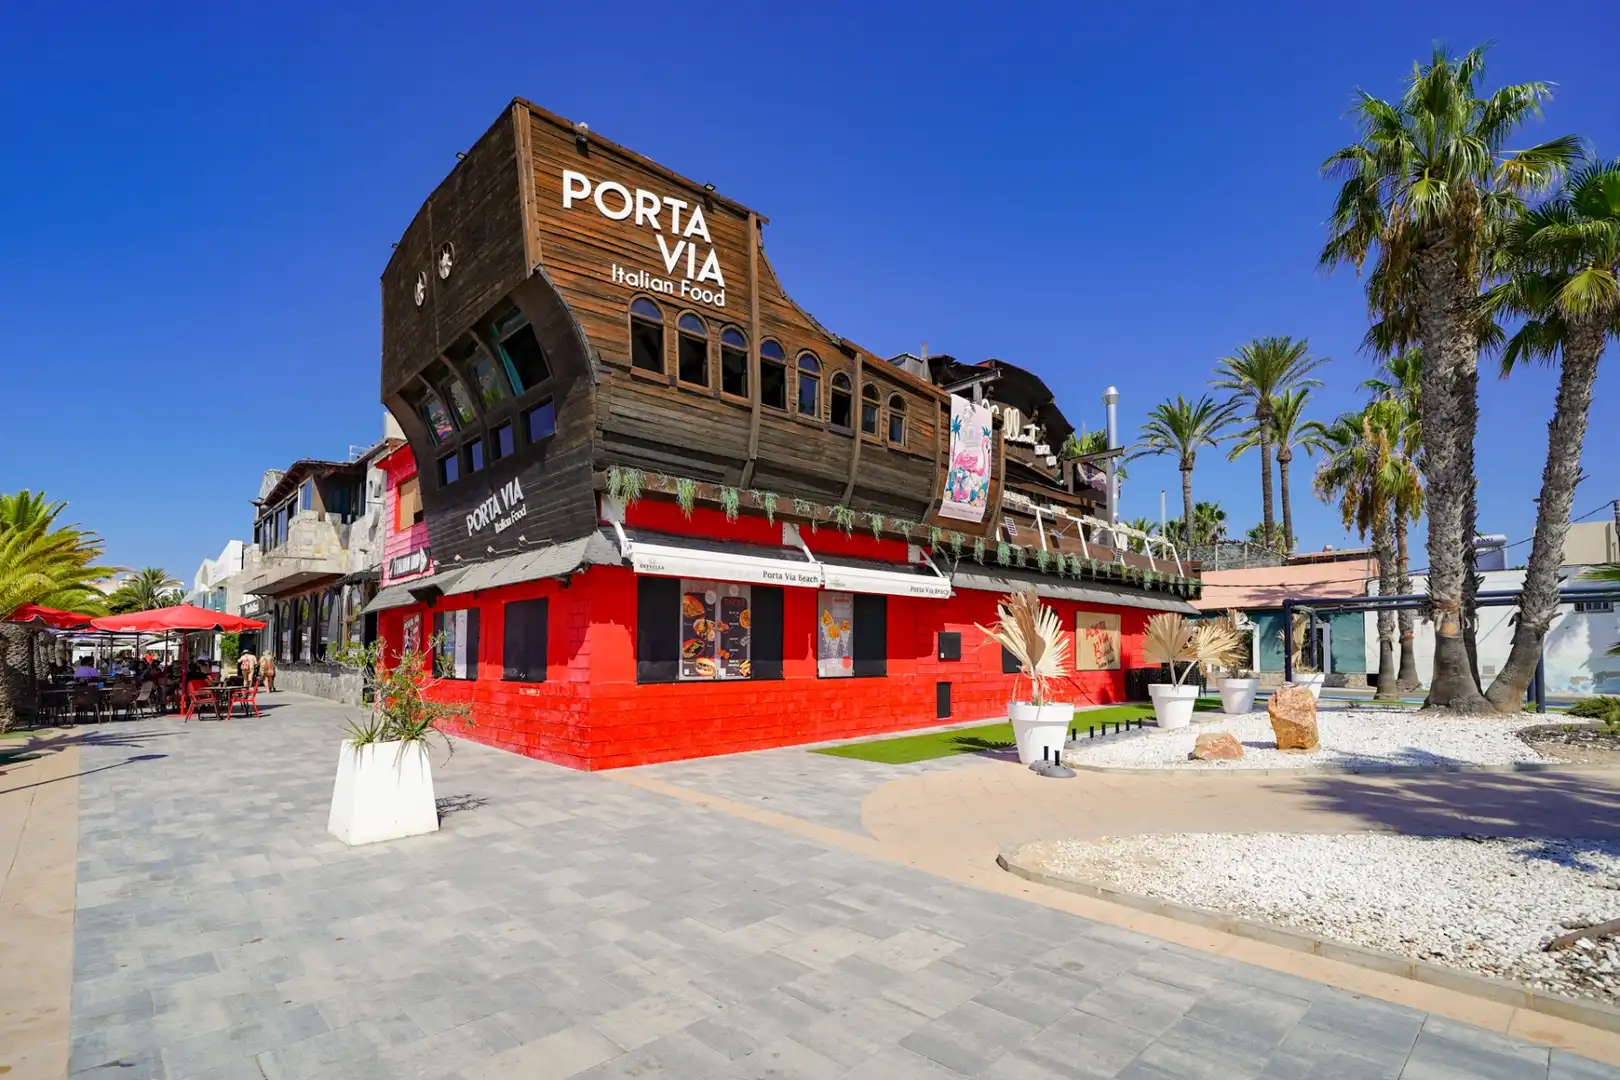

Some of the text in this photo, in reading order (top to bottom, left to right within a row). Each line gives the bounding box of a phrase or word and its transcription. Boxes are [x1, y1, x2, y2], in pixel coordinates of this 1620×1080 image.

[563, 169, 712, 244] PORTA
[656, 234, 726, 288] VIA
[611, 264, 726, 307] Italian Food
[466, 476, 524, 537] PORTA VIA
[510, 503, 527, 523] Food
[762, 570, 819, 583] Porta Via Beach
[910, 585, 924, 593] Porta
